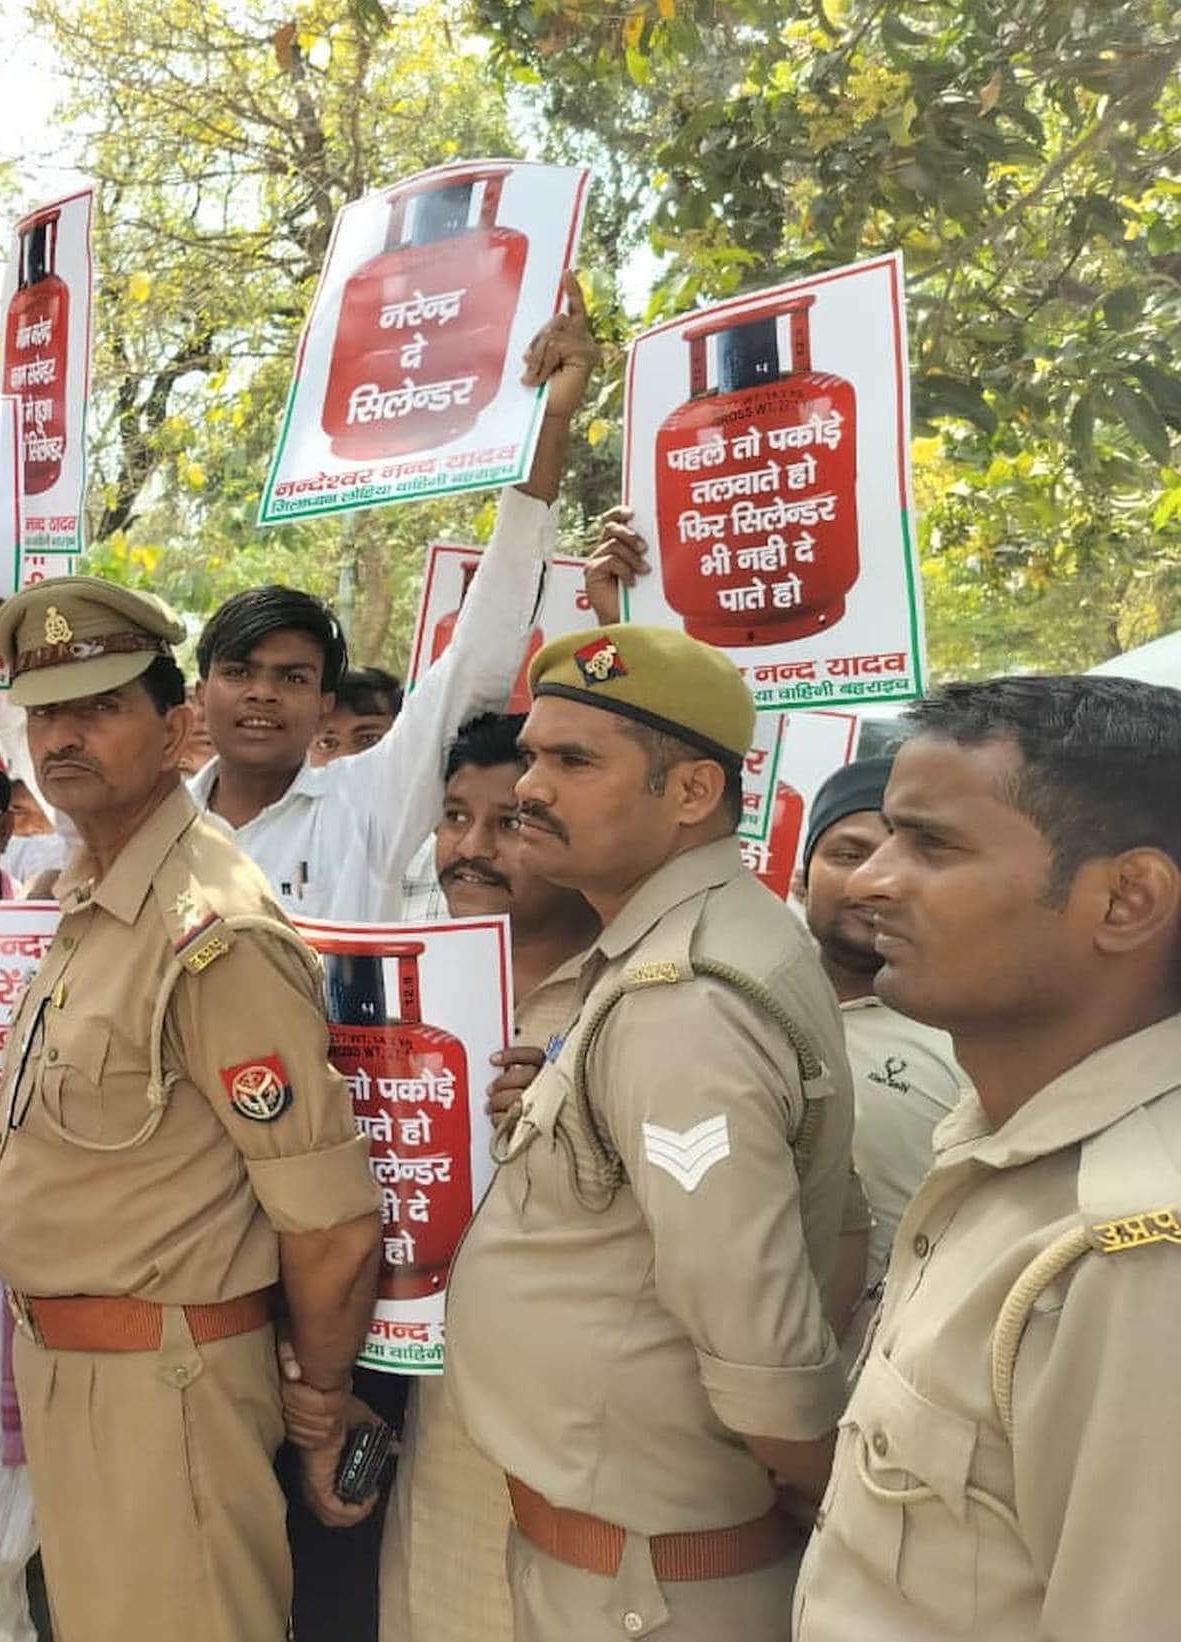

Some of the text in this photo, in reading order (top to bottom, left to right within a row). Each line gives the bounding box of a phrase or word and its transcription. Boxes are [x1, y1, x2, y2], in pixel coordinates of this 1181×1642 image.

[378, 289, 465, 328] नरेन्द्र
[399, 332, 426, 368] दे
[345, 376, 477, 424] सिलेन्डर
[666, 433, 725, 470] पहले
[730, 427, 760, 459] तो
[691, 452, 816, 503] तलवाते हो
[677, 496, 835, 542] फिर सिलेन्डर
[700, 543, 729, 575] भी
[793, 531, 816, 561] दे
[717, 572, 801, 610] पाते हो
[754, 660, 814, 682] नन्द
[825, 652, 906, 676] यादव
[398, 1108, 431, 1144] हो
[407, 1190, 430, 1222] दे
[384, 1230, 414, 1264] हो
